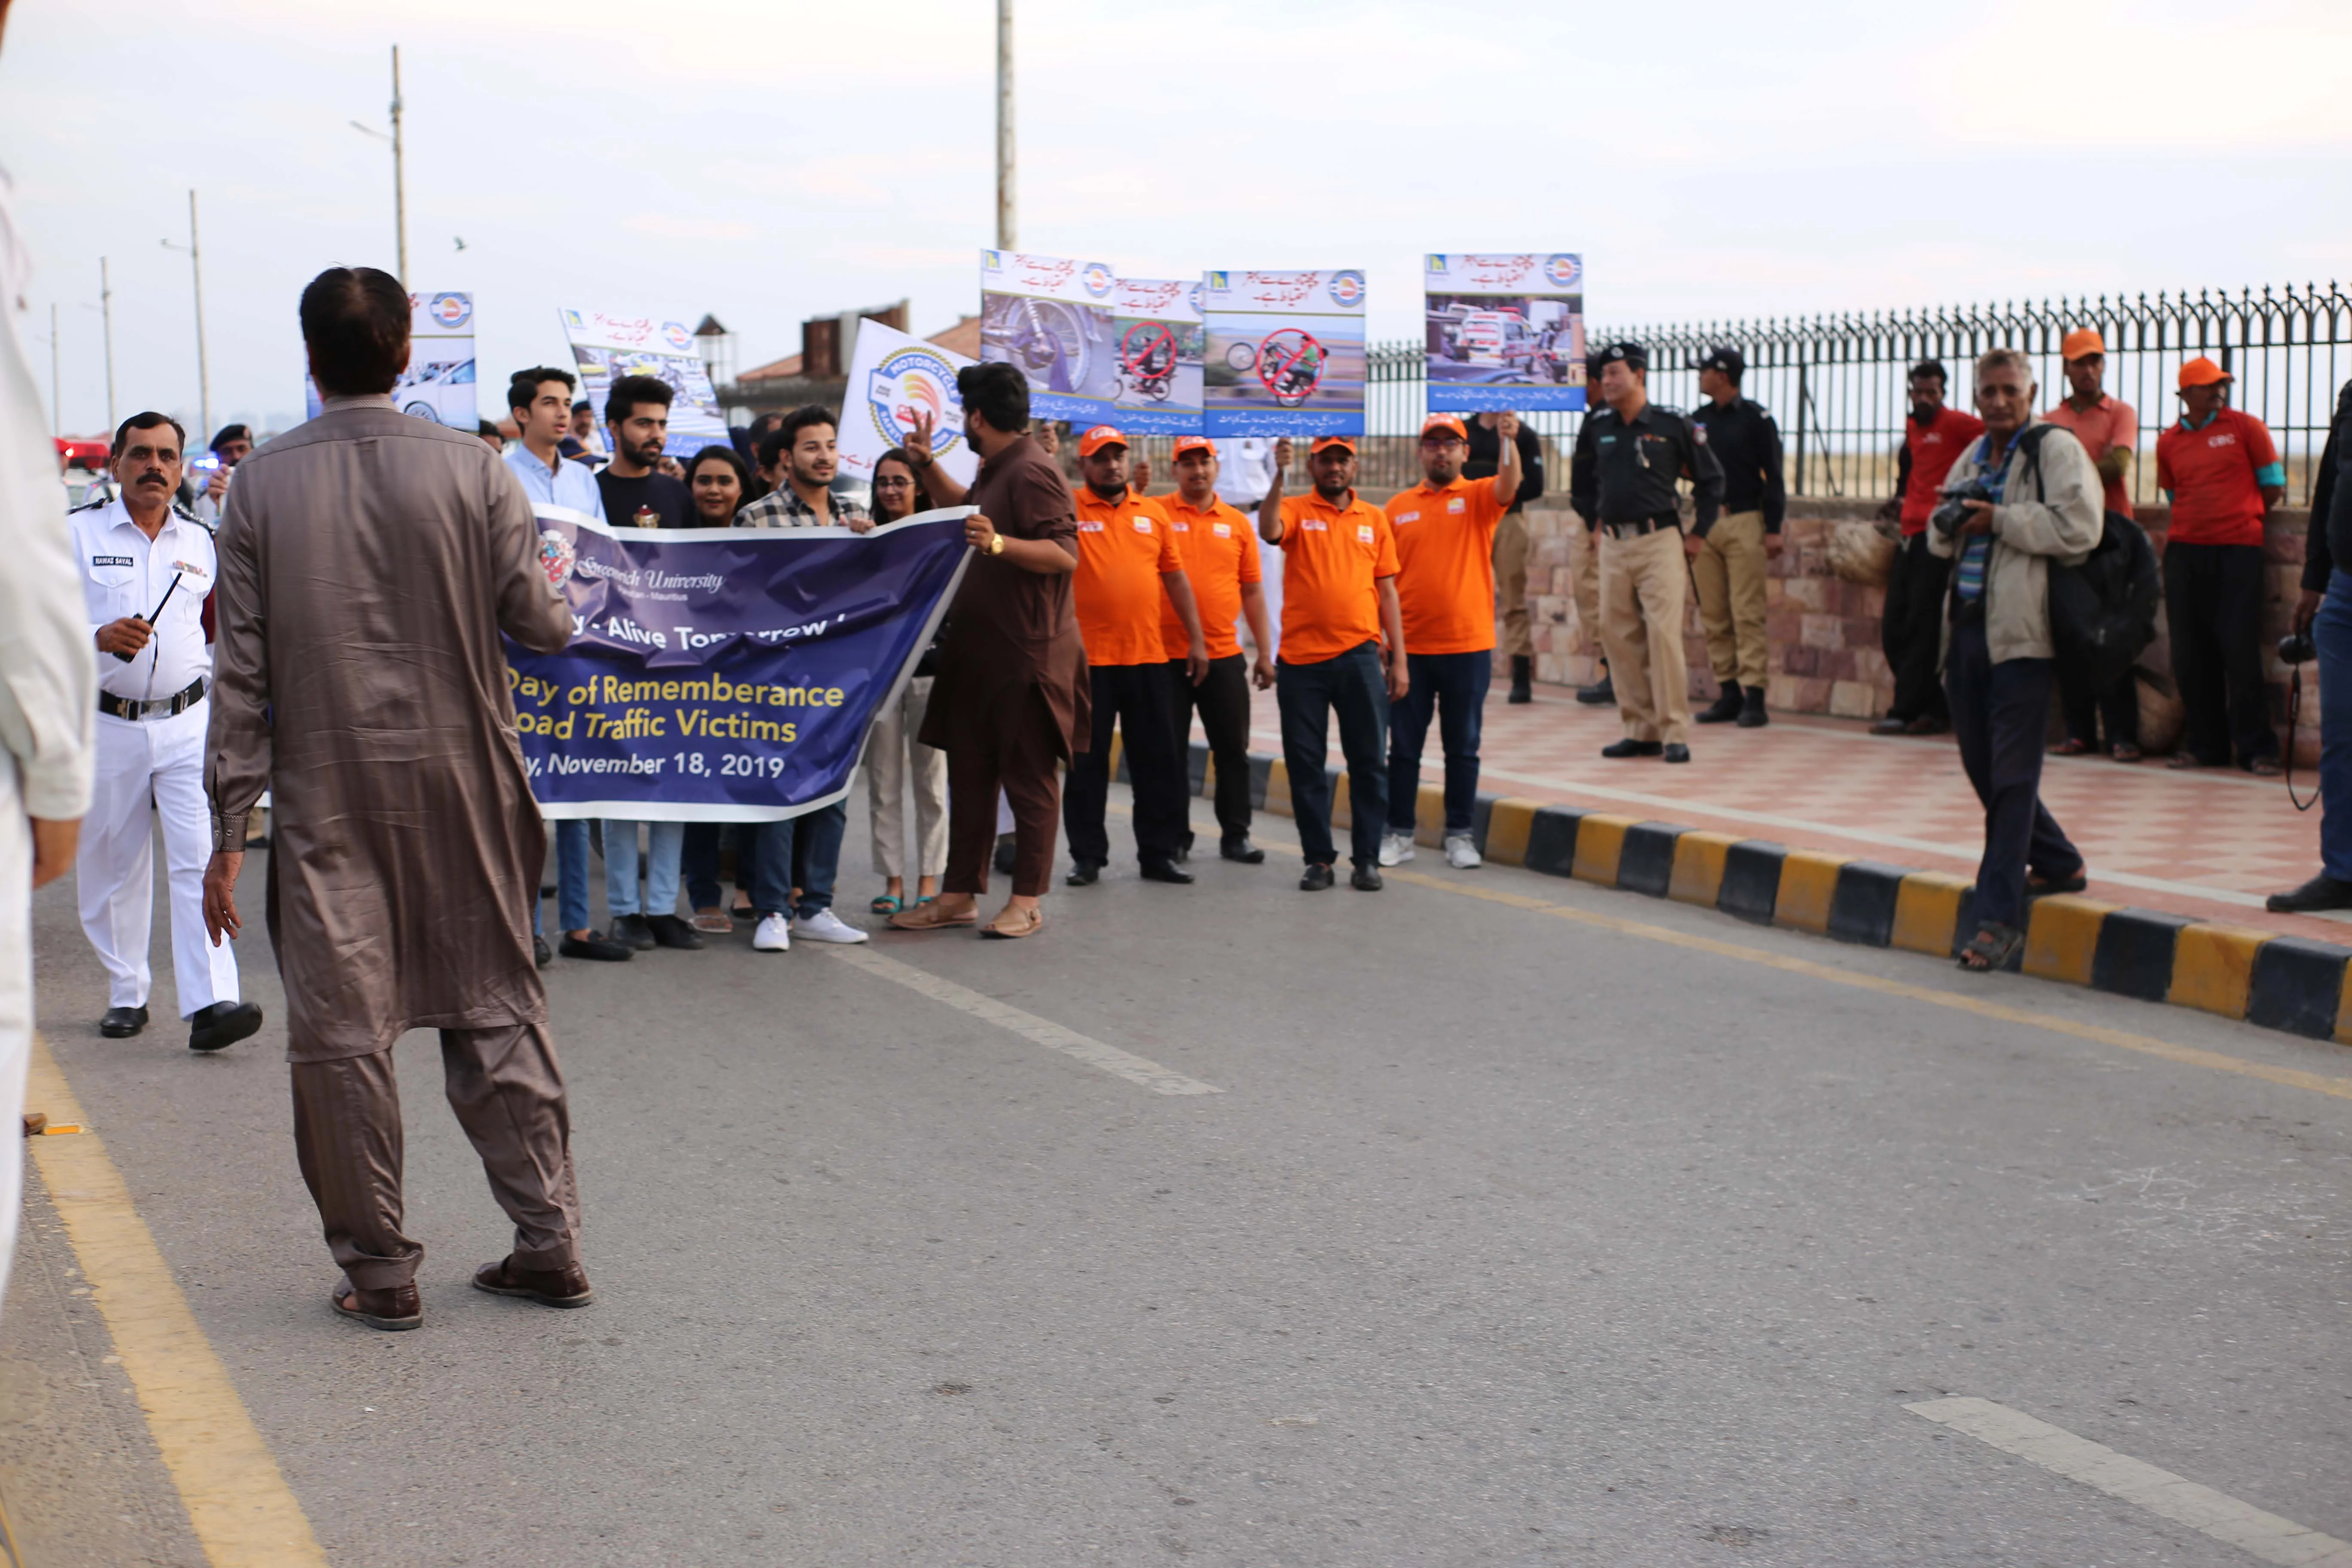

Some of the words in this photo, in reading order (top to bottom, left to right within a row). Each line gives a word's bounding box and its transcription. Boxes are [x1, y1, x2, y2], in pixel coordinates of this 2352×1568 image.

[890, 357, 959, 398] MOTORCYCLE
[645, 570, 726, 594] University
[608, 616, 667, 649] Alive
[674, 620, 828, 650] Torrow
[567, 674, 599, 706] of
[603, 672, 845, 707] Rememberance
[516, 710, 576, 740] oad
[585, 707, 666, 740] Traffic
[675, 709, 796, 743] Victims
[547, 753, 666, 775] November
[674, 752, 711, 778] 18,
[720, 754, 785, 778] 2019
